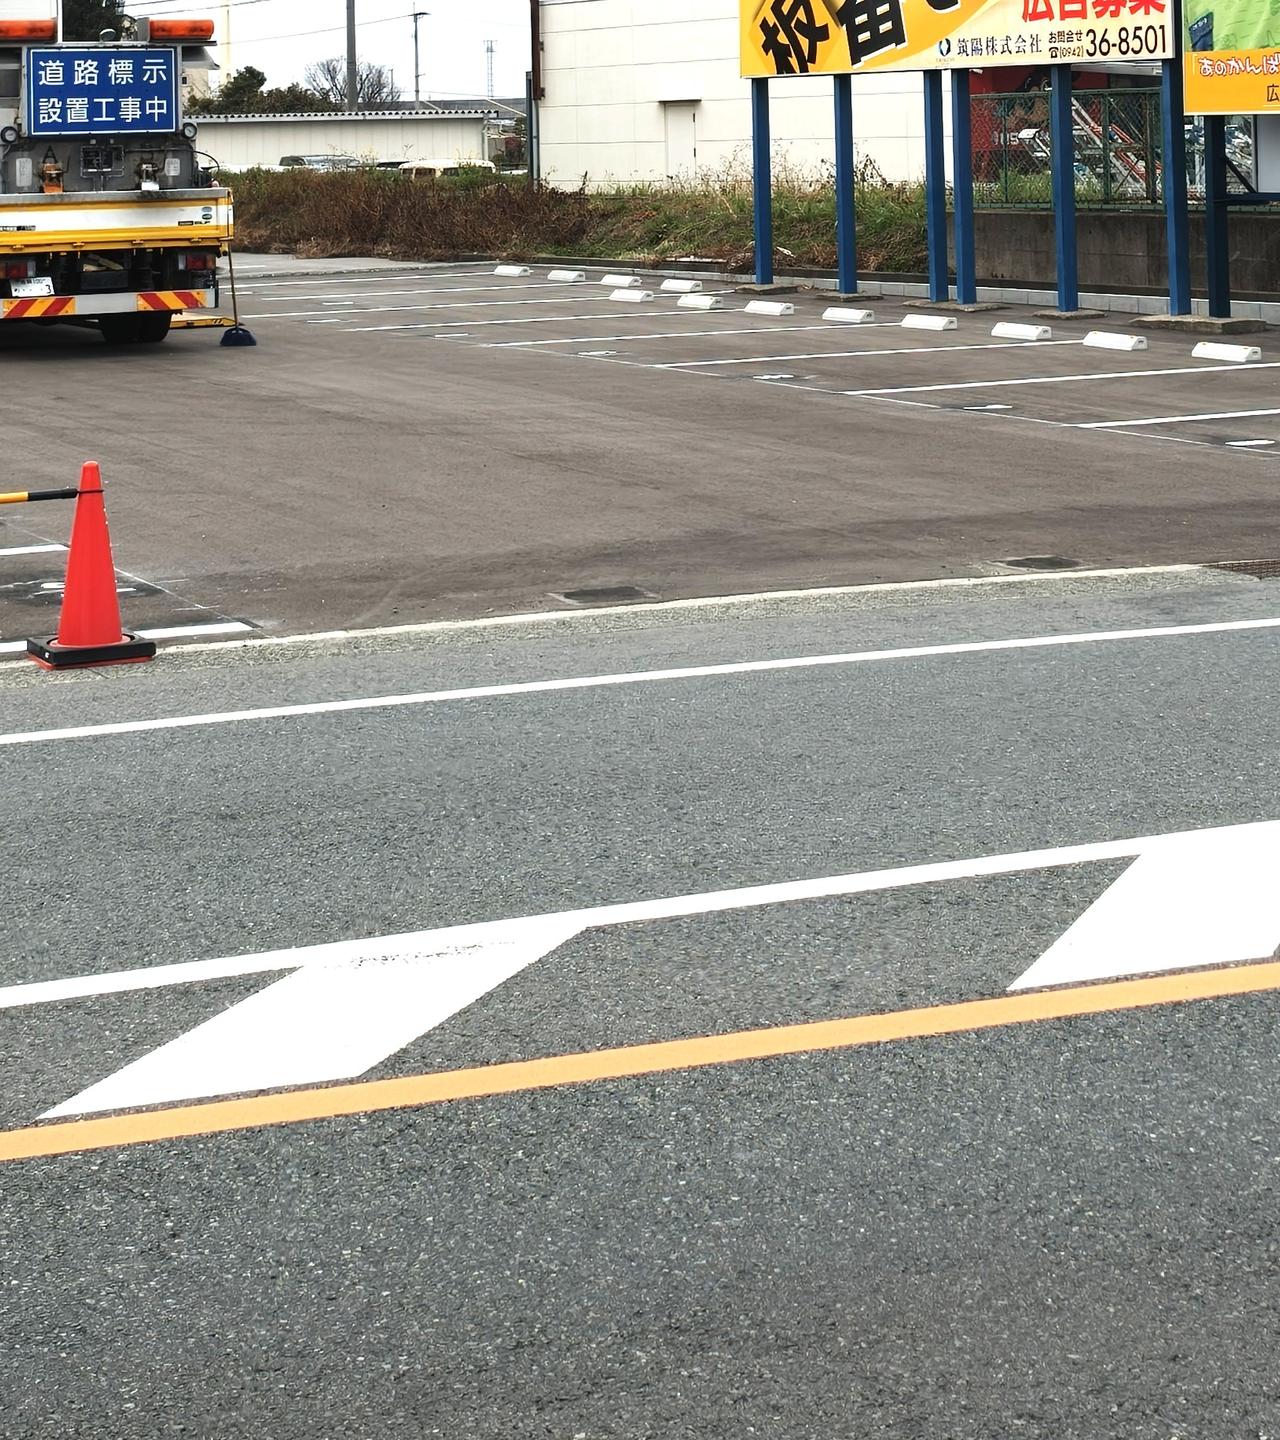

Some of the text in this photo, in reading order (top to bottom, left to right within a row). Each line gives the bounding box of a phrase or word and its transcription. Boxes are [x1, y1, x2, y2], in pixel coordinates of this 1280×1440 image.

[957, 34, 1043, 57] 筑陽株式会社
[1048, 30, 1084, 44] お問合せ
[1085, 25, 1167, 58] 36-8501
[38, 58, 167, 86] 道路標示
[38, 95, 168, 125] 設置工事中
